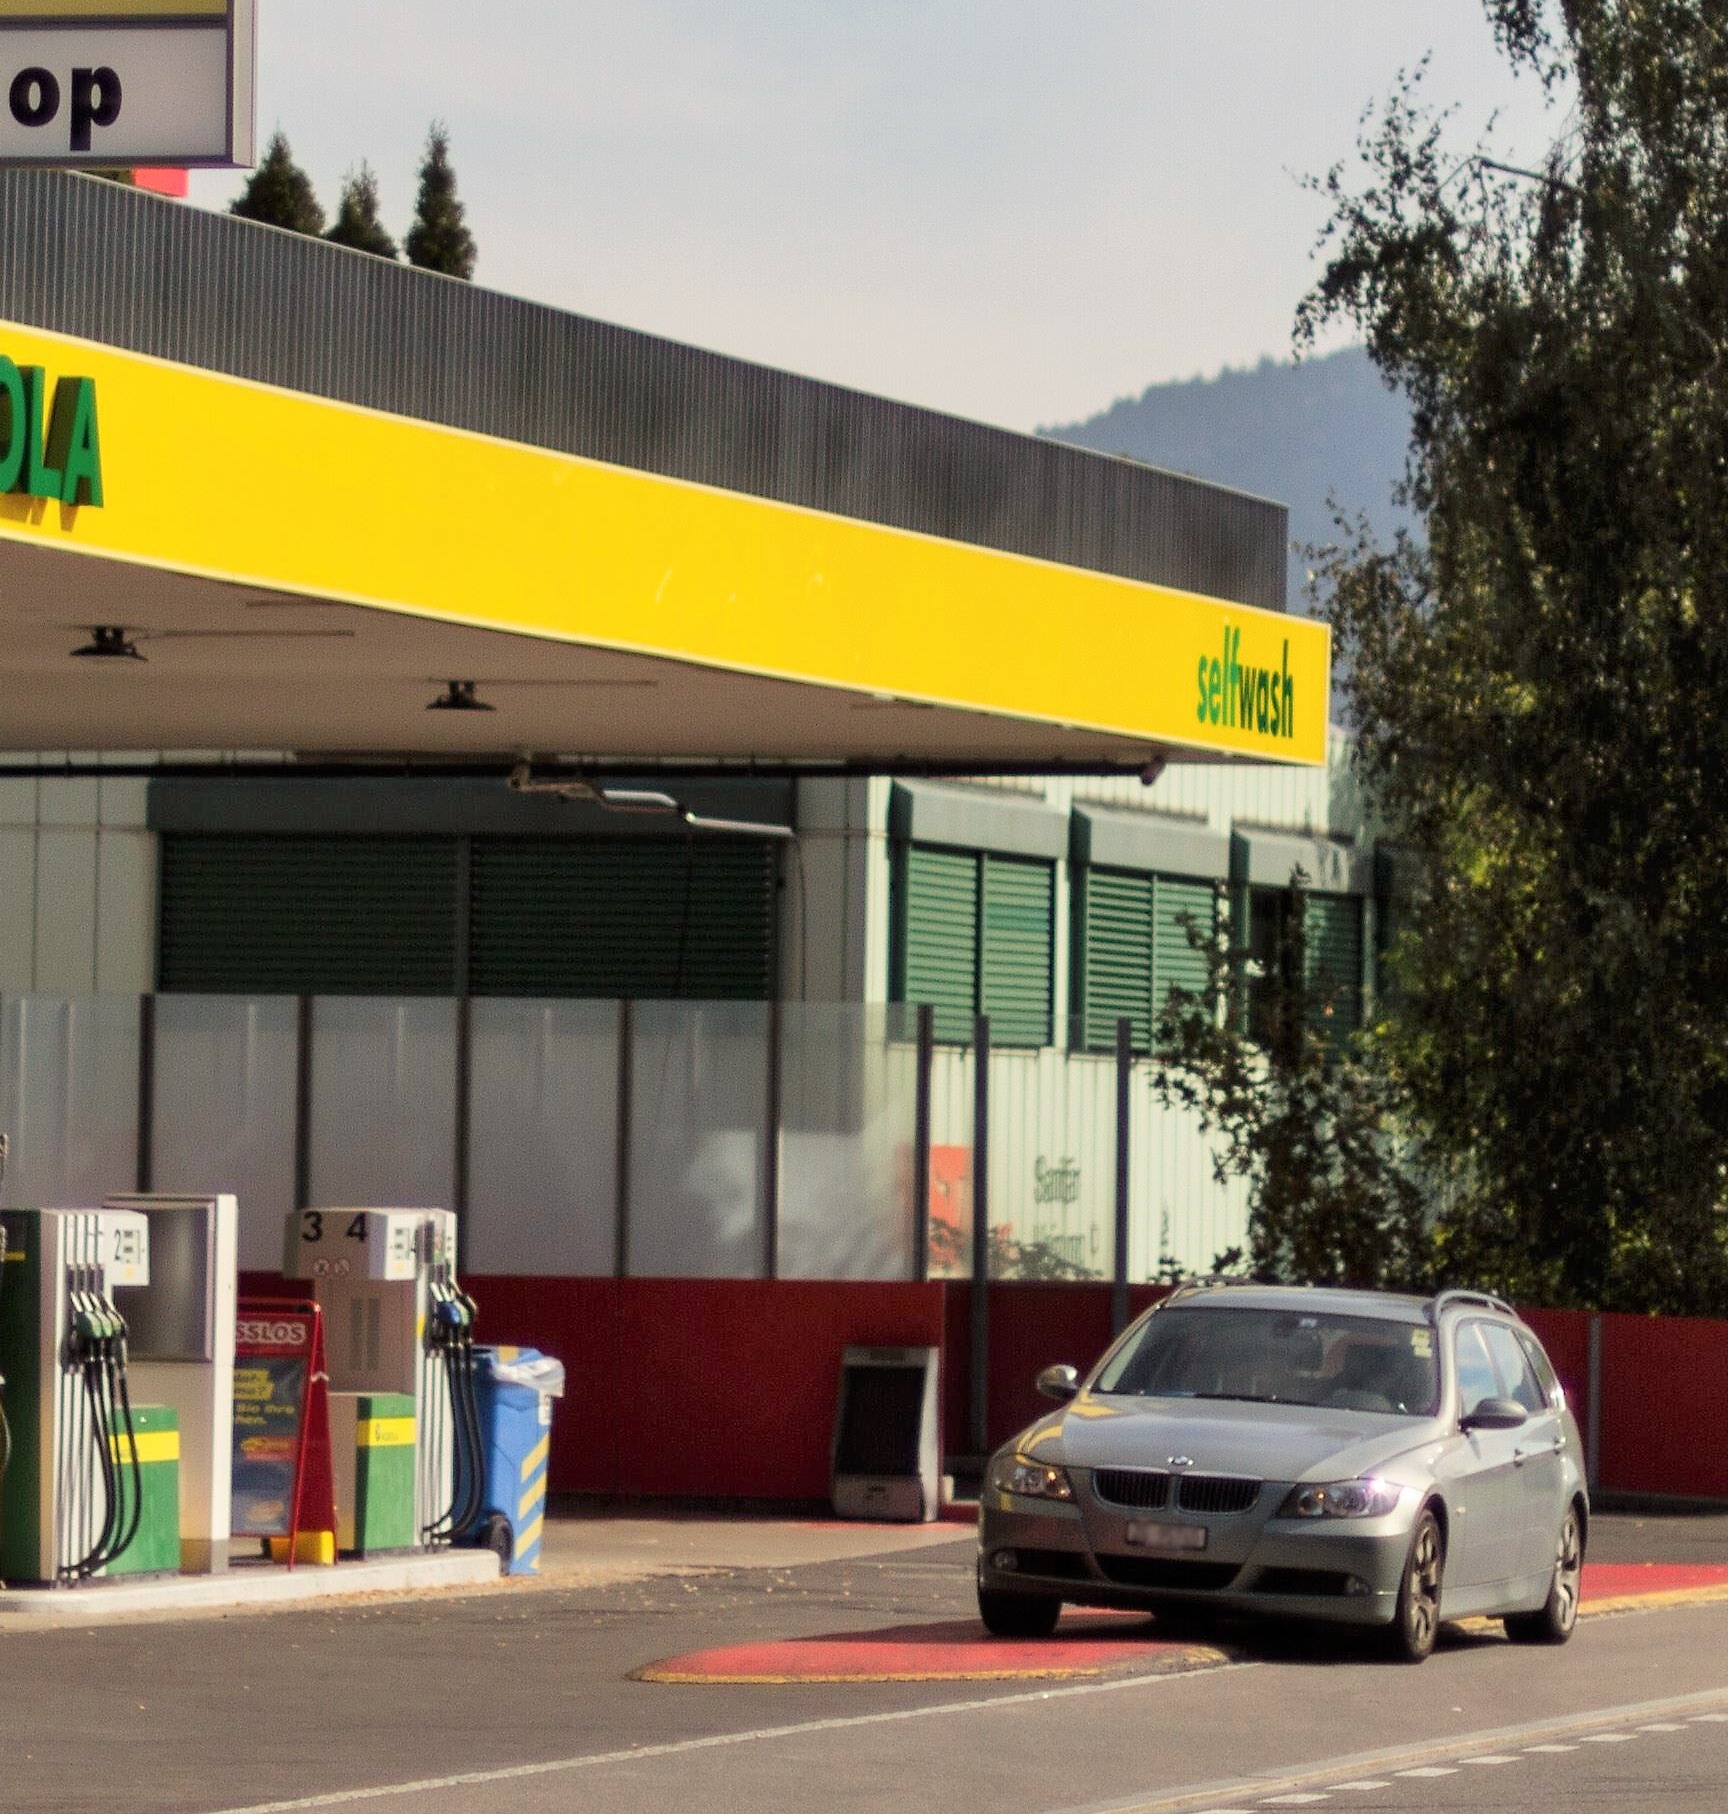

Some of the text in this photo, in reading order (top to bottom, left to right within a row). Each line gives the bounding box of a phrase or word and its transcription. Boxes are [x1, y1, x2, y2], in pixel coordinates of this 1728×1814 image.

[1197, 625, 1294, 738] selfwash
[302, 1211, 368, 1243] 3 4
[113, 1228, 122, 1262] 2
